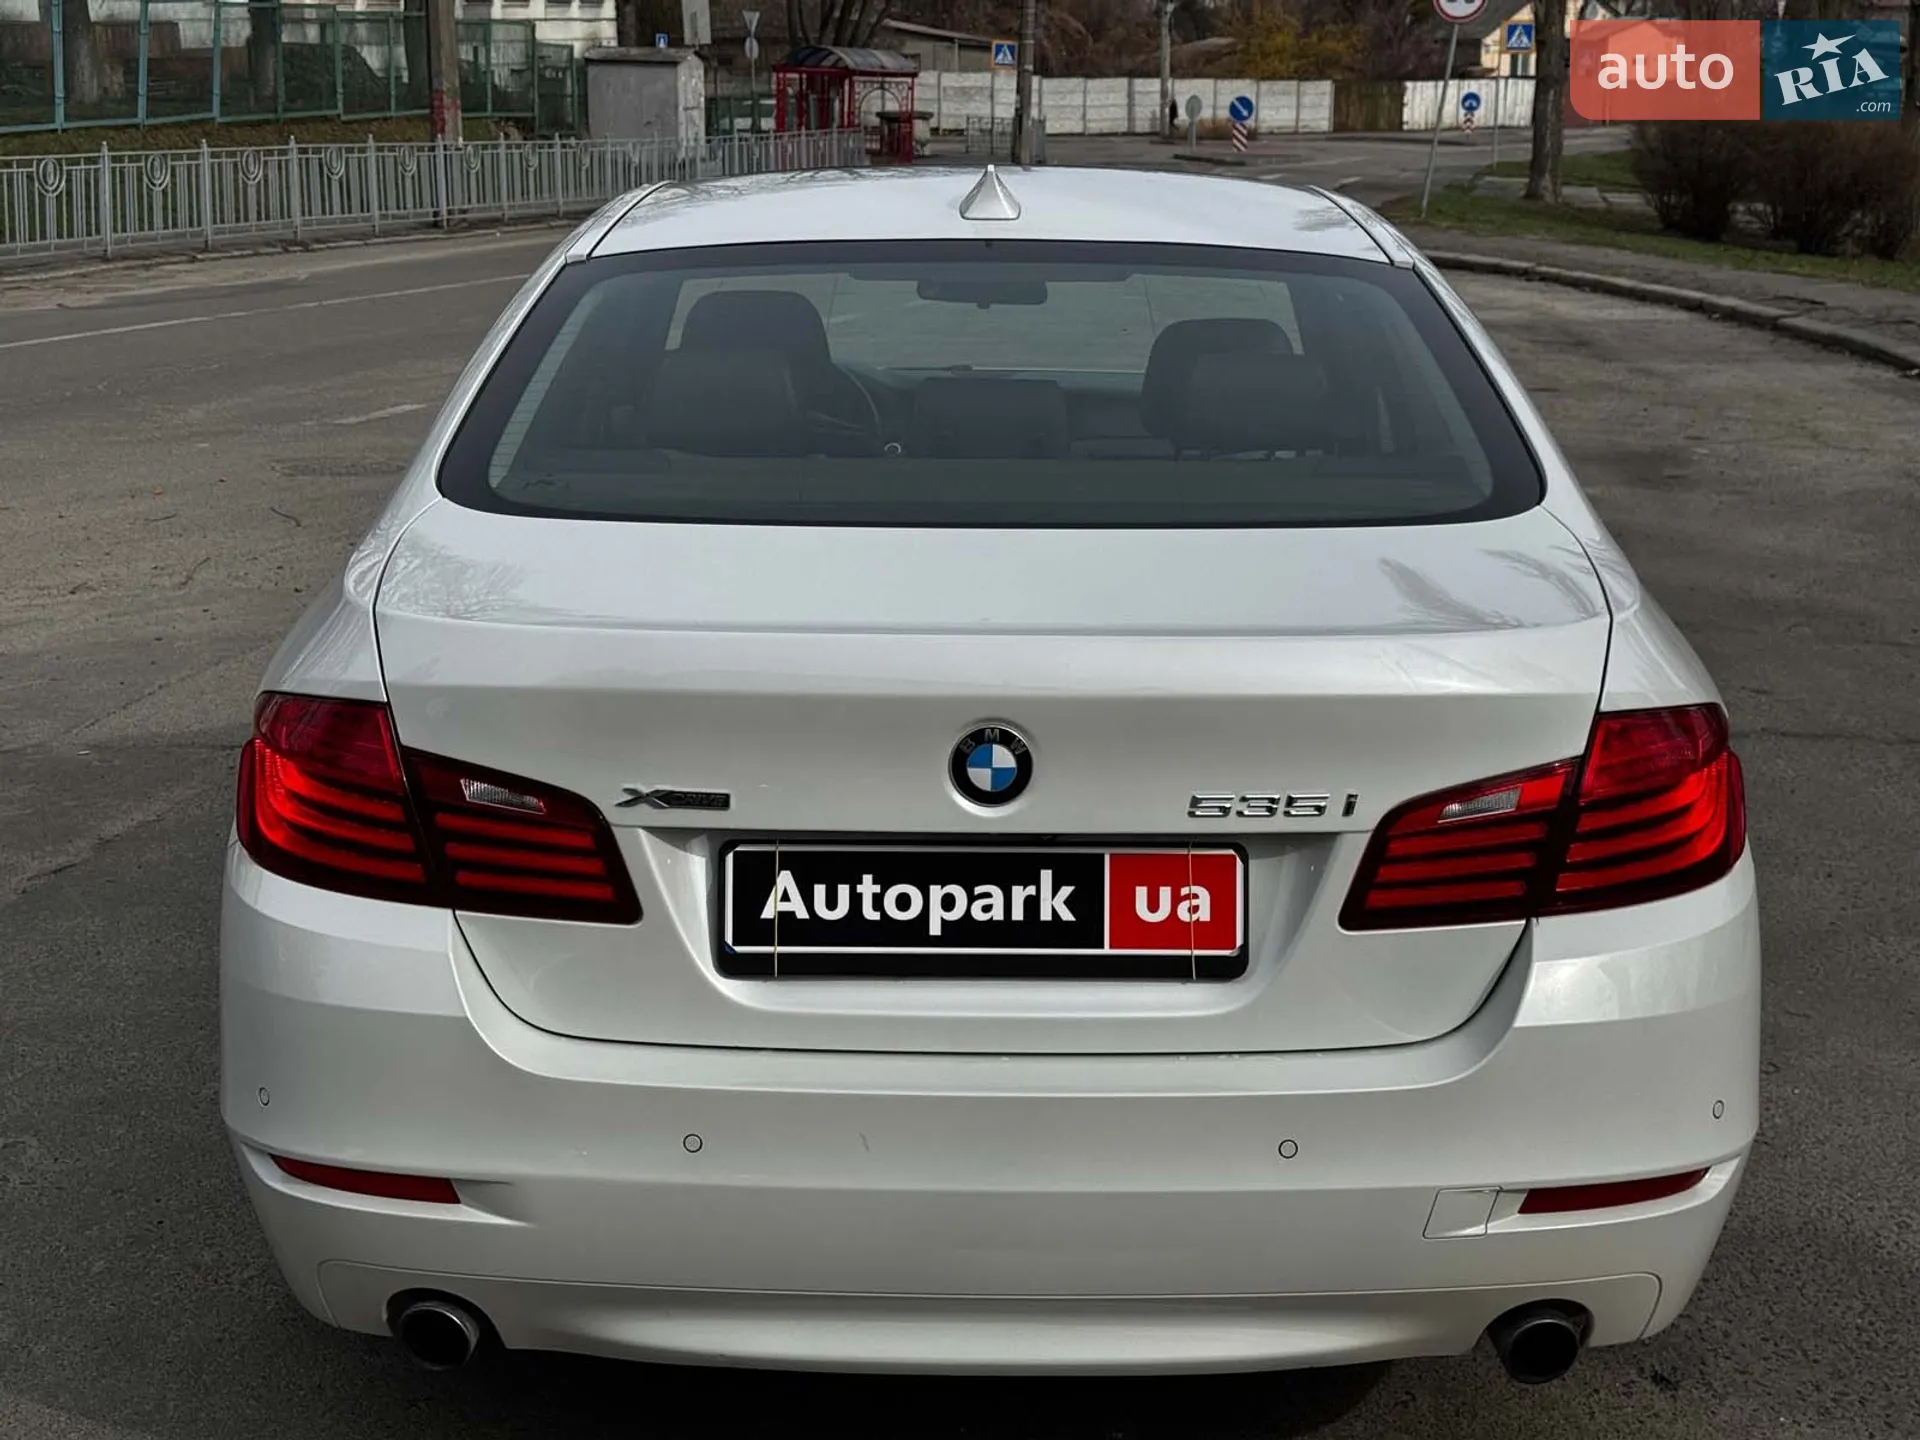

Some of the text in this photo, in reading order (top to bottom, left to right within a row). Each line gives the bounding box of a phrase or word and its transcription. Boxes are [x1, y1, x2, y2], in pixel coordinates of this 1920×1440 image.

[959, 728, 1027, 755] BMW
[760, 869, 1211, 936] Autopark ua
